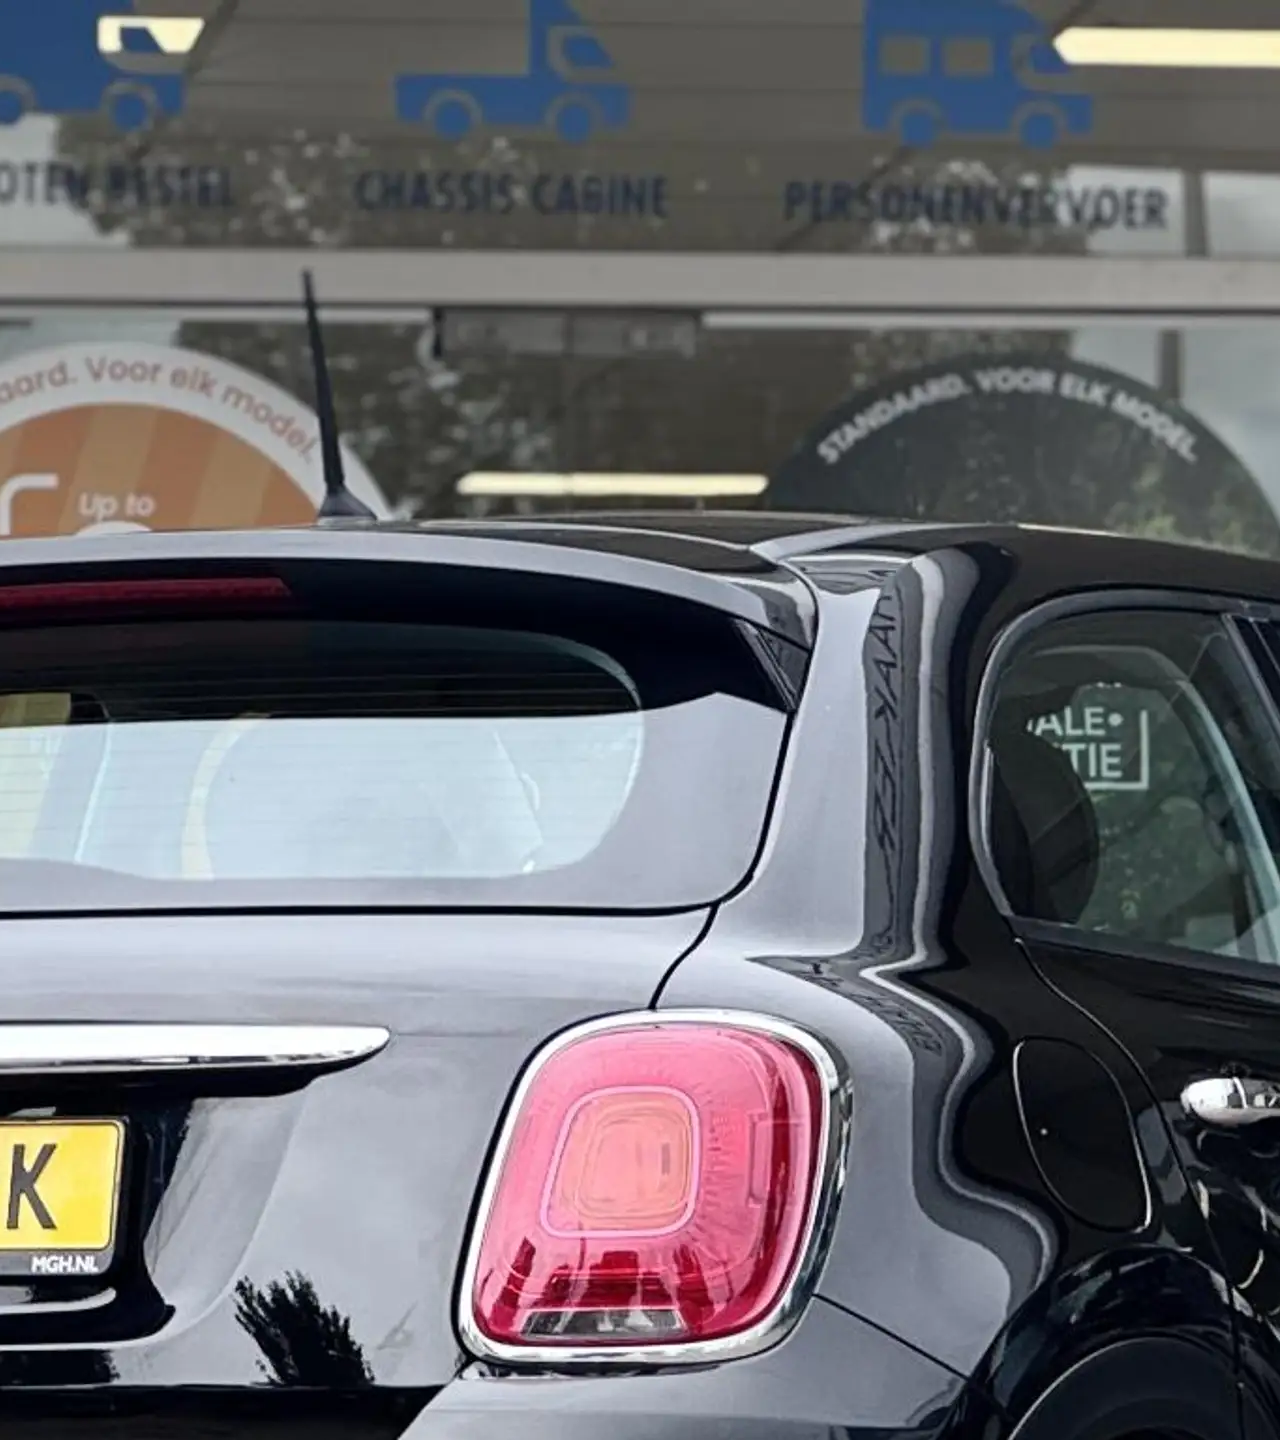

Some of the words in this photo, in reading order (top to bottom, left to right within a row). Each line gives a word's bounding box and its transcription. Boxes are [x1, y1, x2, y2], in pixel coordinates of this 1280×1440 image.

[354, 169, 517, 215] CHASSIS
[529, 173, 669, 219] CABINE
[784, 180, 1171, 231] PERSONENVERVOER
[84, 355, 163, 383] Voor
[170, 365, 218, 398] elk
[221, 383, 318, 466] model.
[817, 373, 971, 465] STANDAARD.
[974, 366, 1057, 394] VOOR
[1059, 371, 1111, 407] ELK
[78, 491, 118, 523] Up
[124, 490, 156, 518] to
[31, 1254, 100, 1274] MGH.NL
